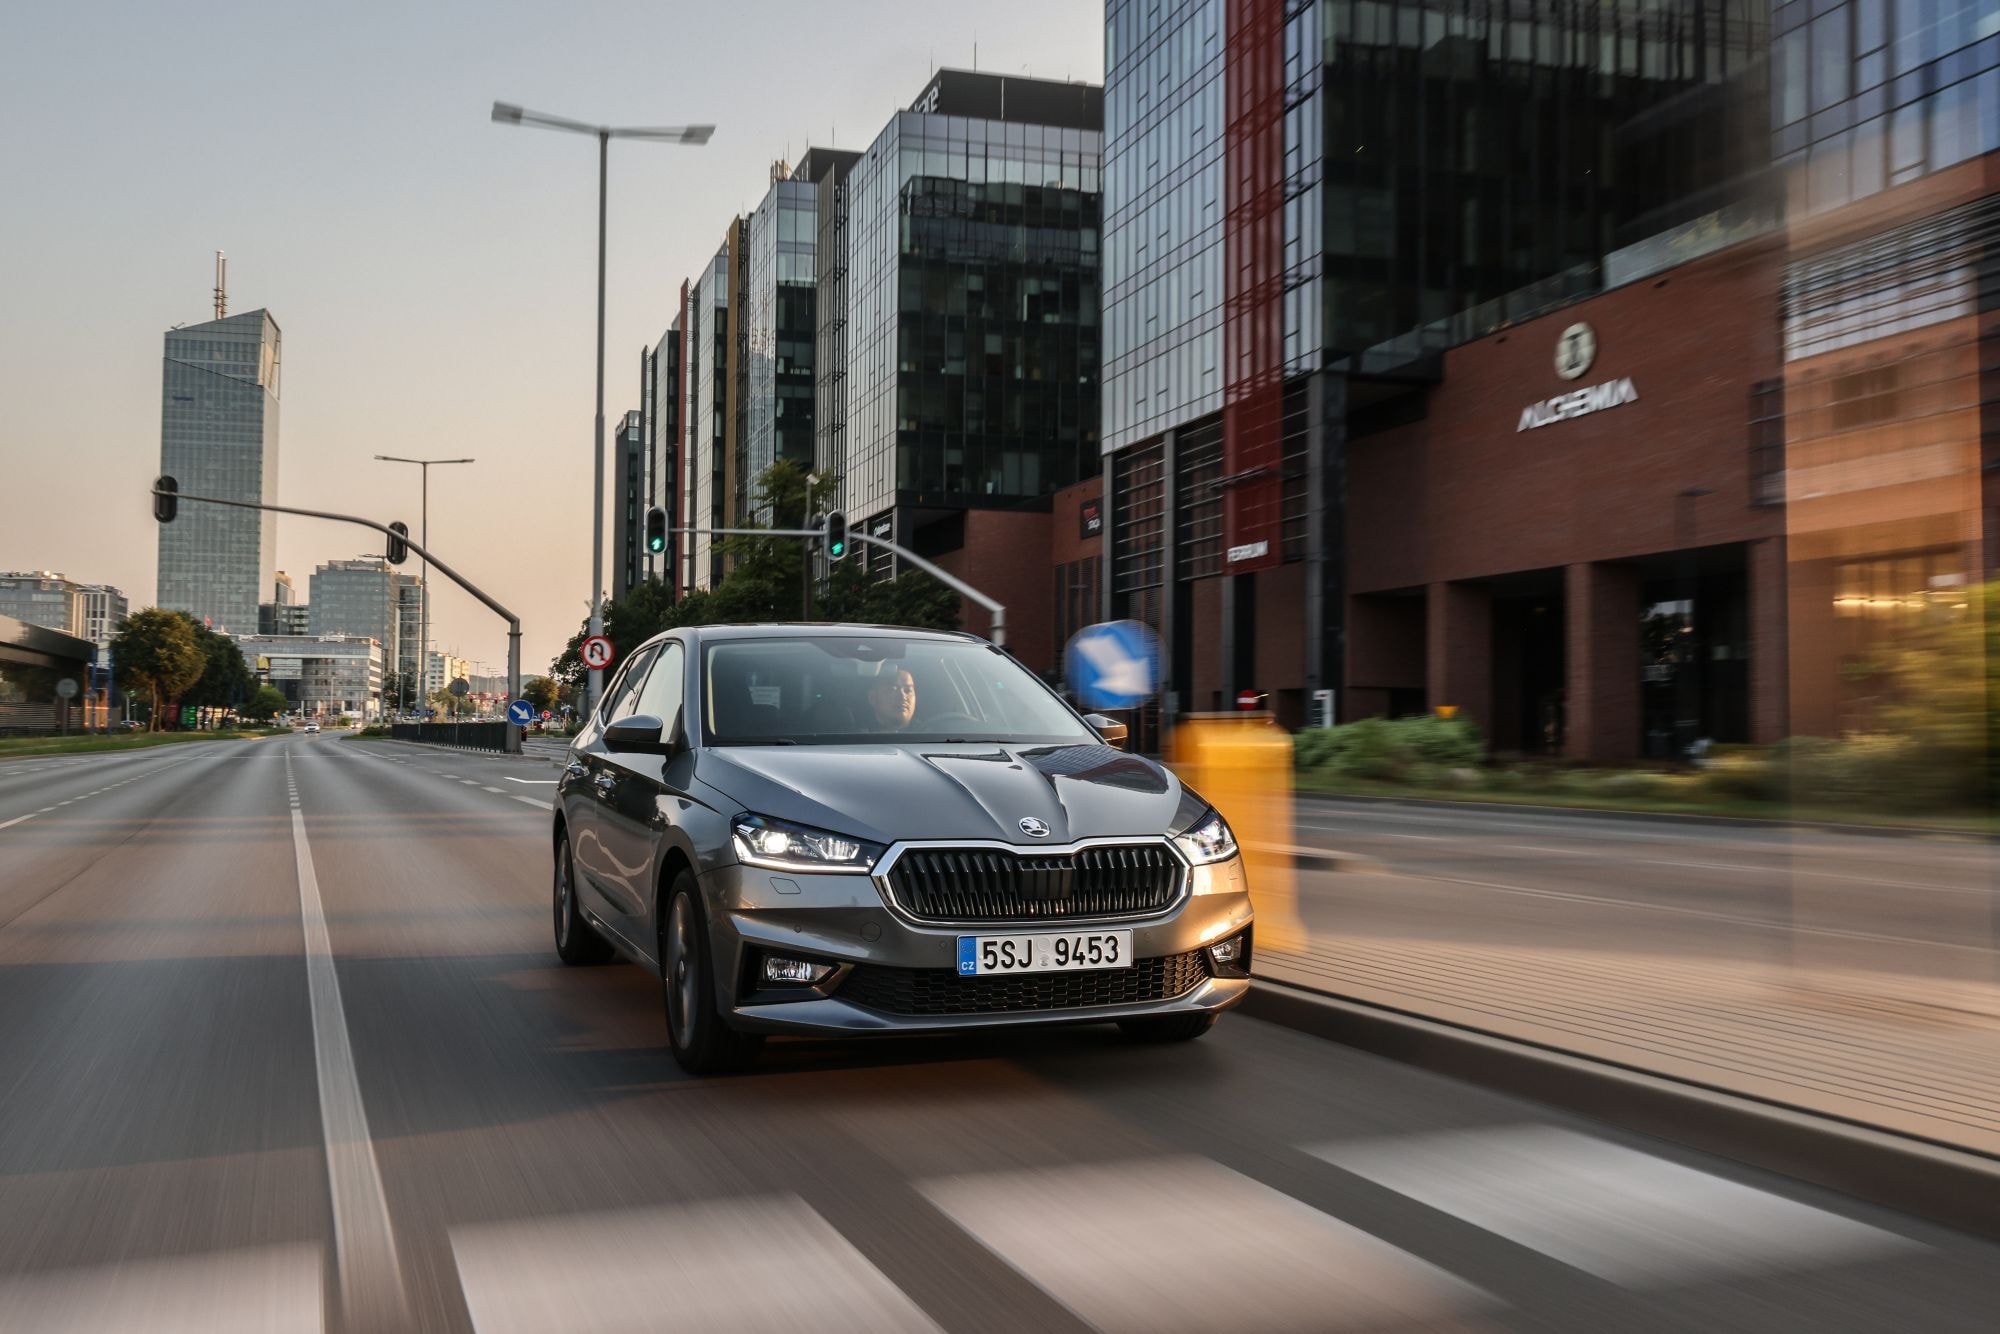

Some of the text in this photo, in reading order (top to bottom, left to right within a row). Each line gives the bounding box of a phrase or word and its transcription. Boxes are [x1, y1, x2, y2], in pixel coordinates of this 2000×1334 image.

[982, 935, 1120, 970] 5SJ 9453
[961, 961, 975, 971] CZ
